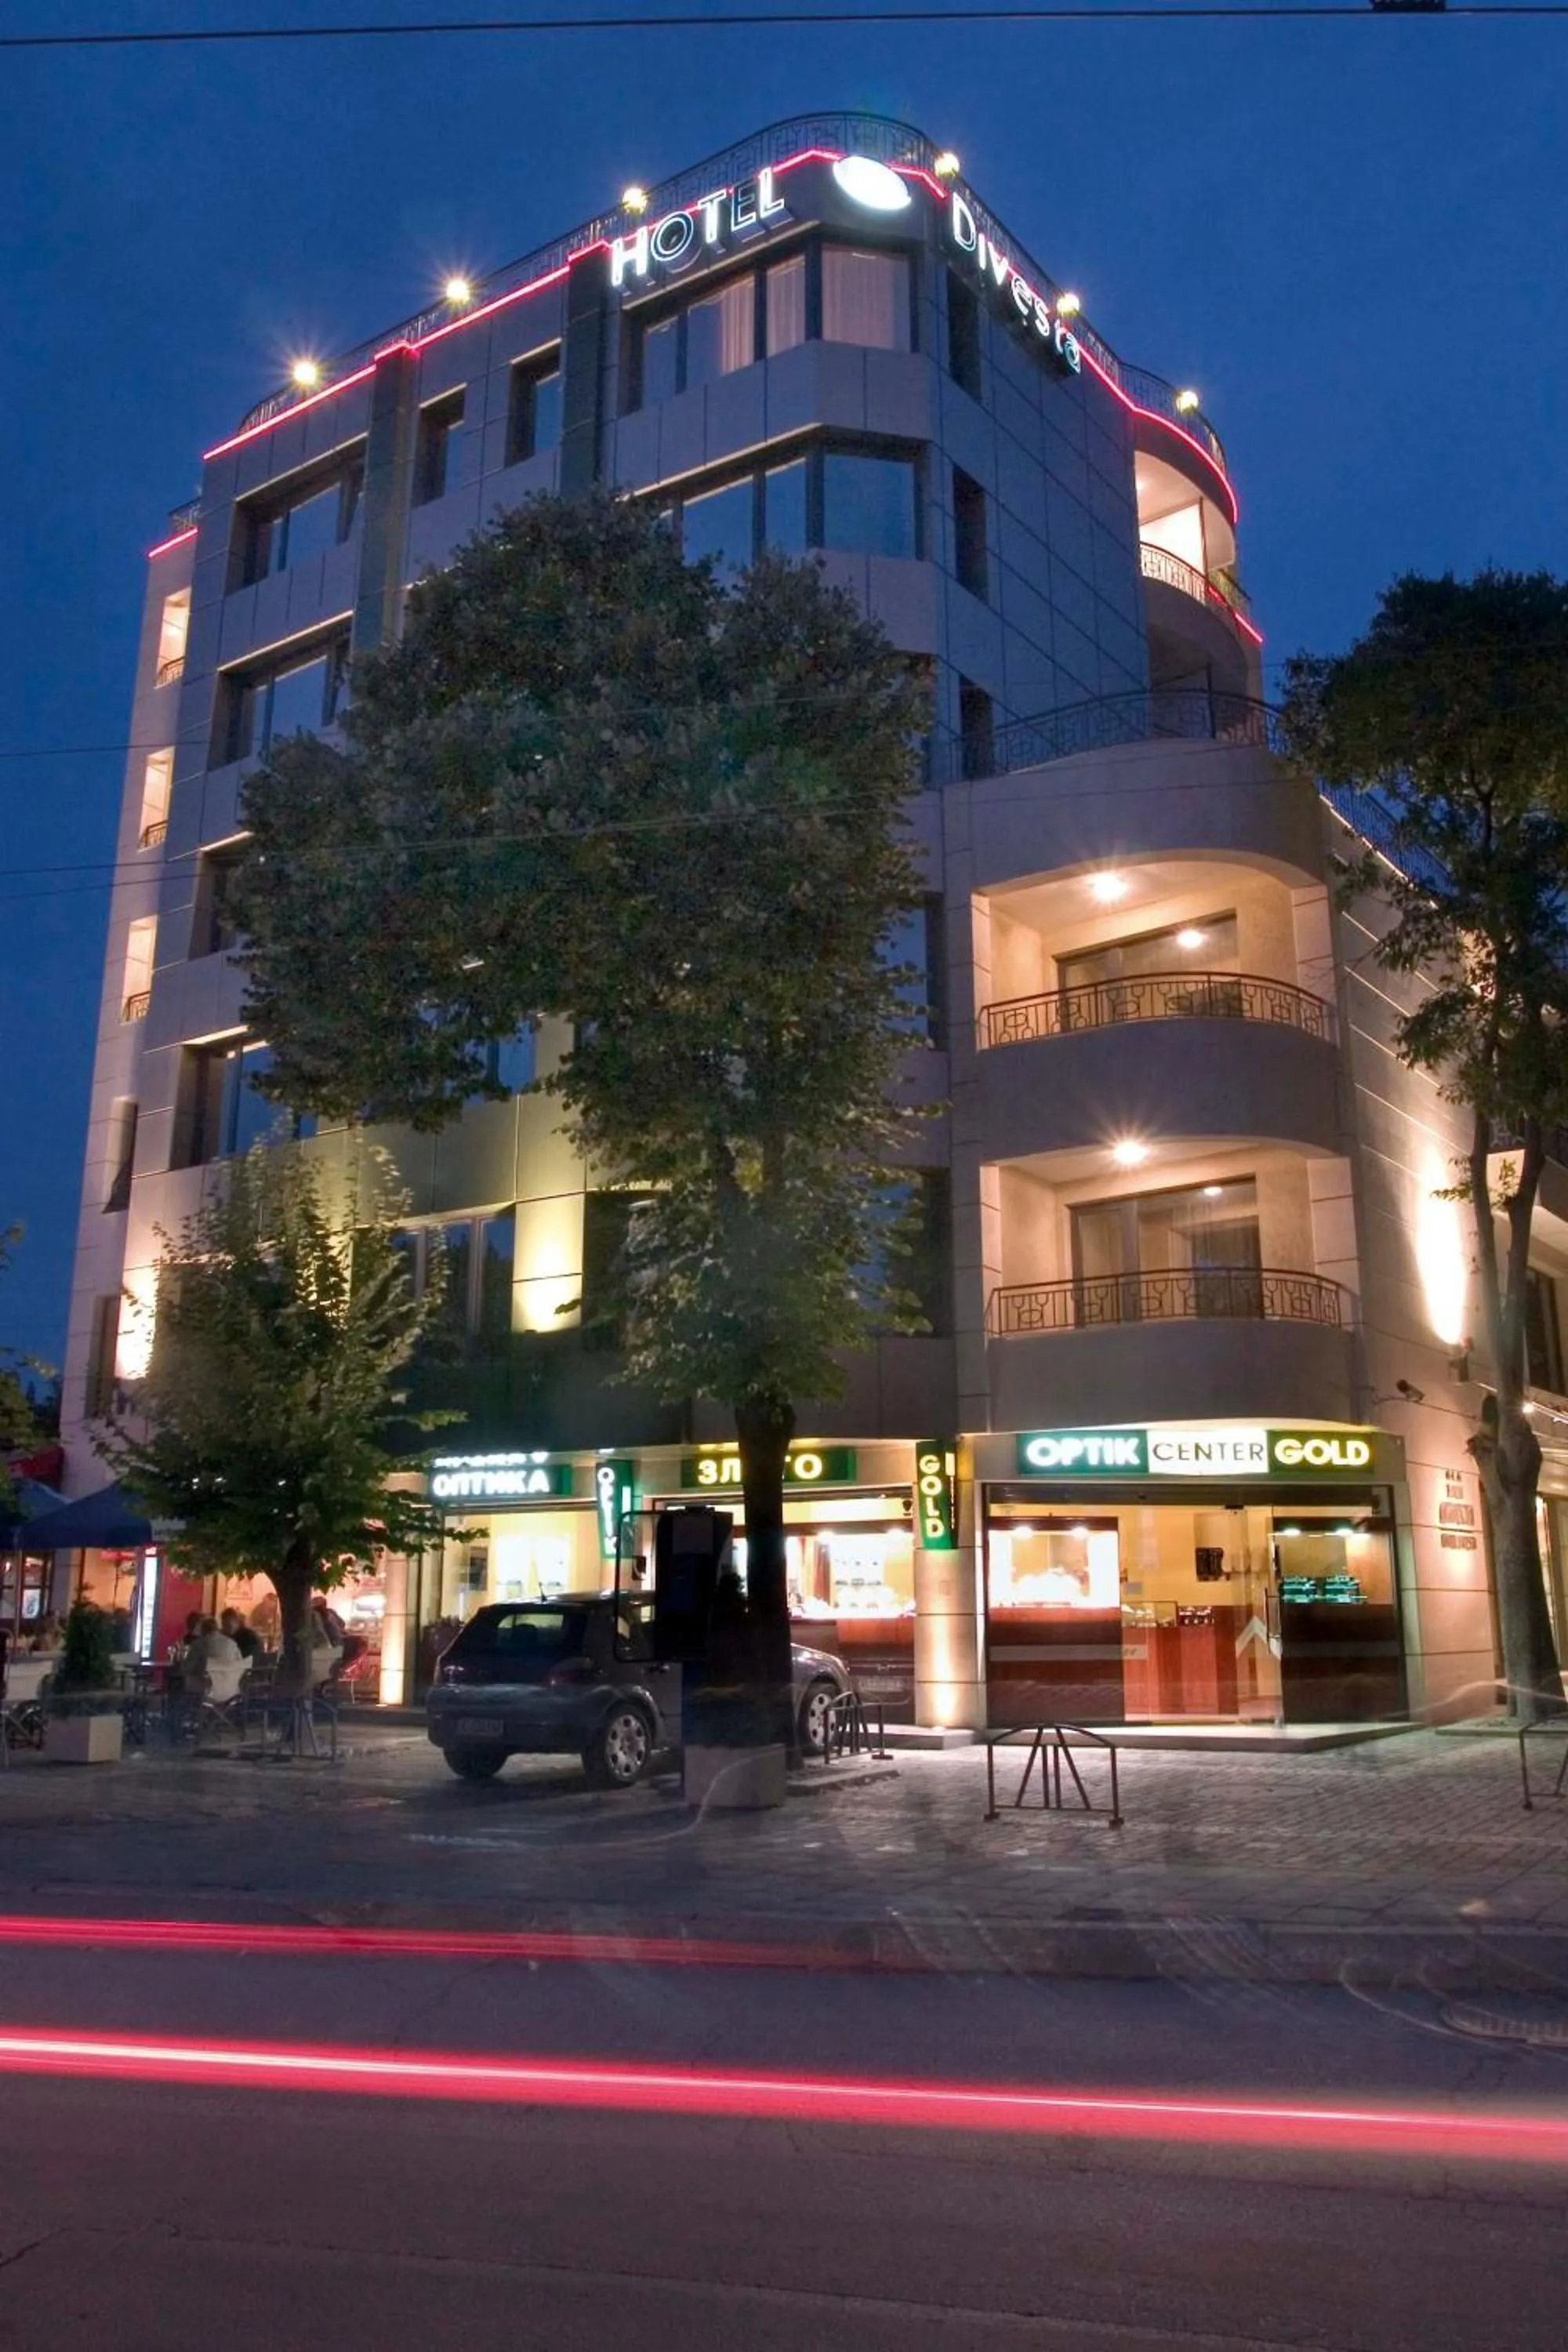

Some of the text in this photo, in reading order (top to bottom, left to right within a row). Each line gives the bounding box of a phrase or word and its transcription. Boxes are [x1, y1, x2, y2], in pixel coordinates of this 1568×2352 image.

[611, 166, 785, 287] HOTEL
[697, 1454, 823, 1485] ЗЛО
[1026, 1437, 1370, 1467] OPTIK CENTER GOLD
[919, 1454, 945, 1539] GOLD
